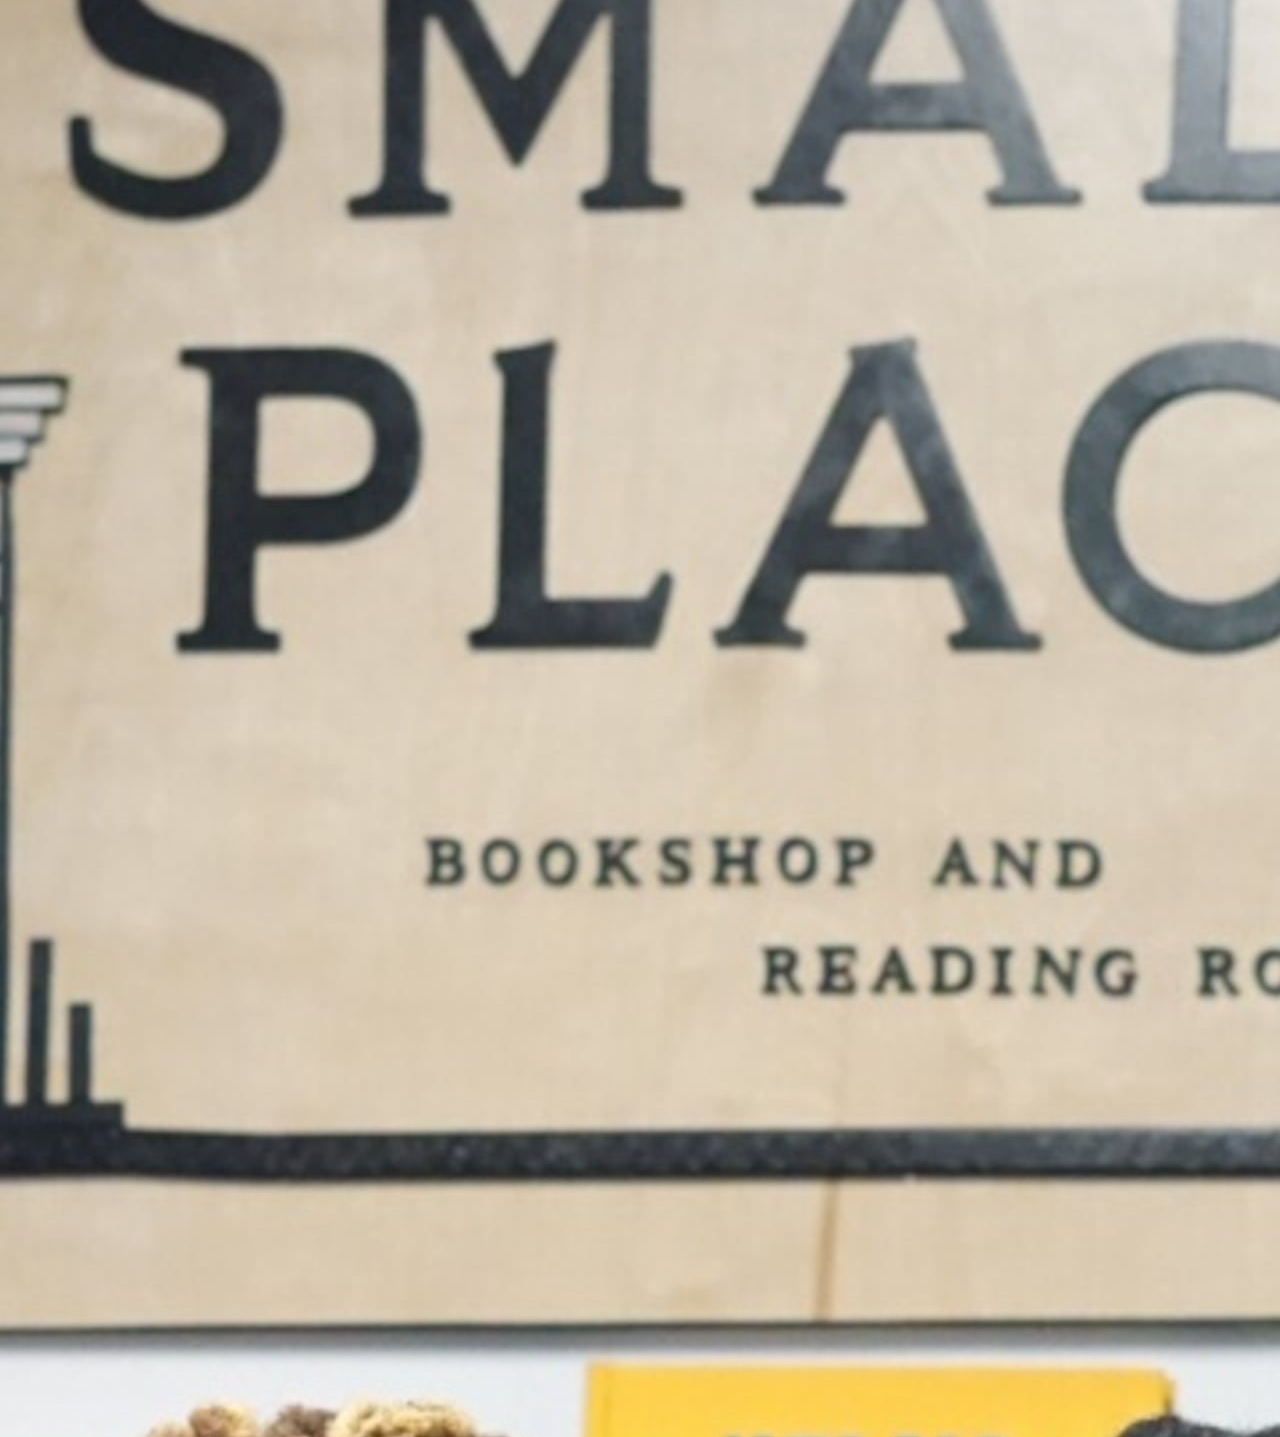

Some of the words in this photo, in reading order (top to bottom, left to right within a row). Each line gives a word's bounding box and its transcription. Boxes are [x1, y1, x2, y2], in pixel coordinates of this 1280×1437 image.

[425, 837, 876, 889] BOOKSHOP
[932, 837, 1104, 890] AND
[760, 946, 1138, 999] READING
